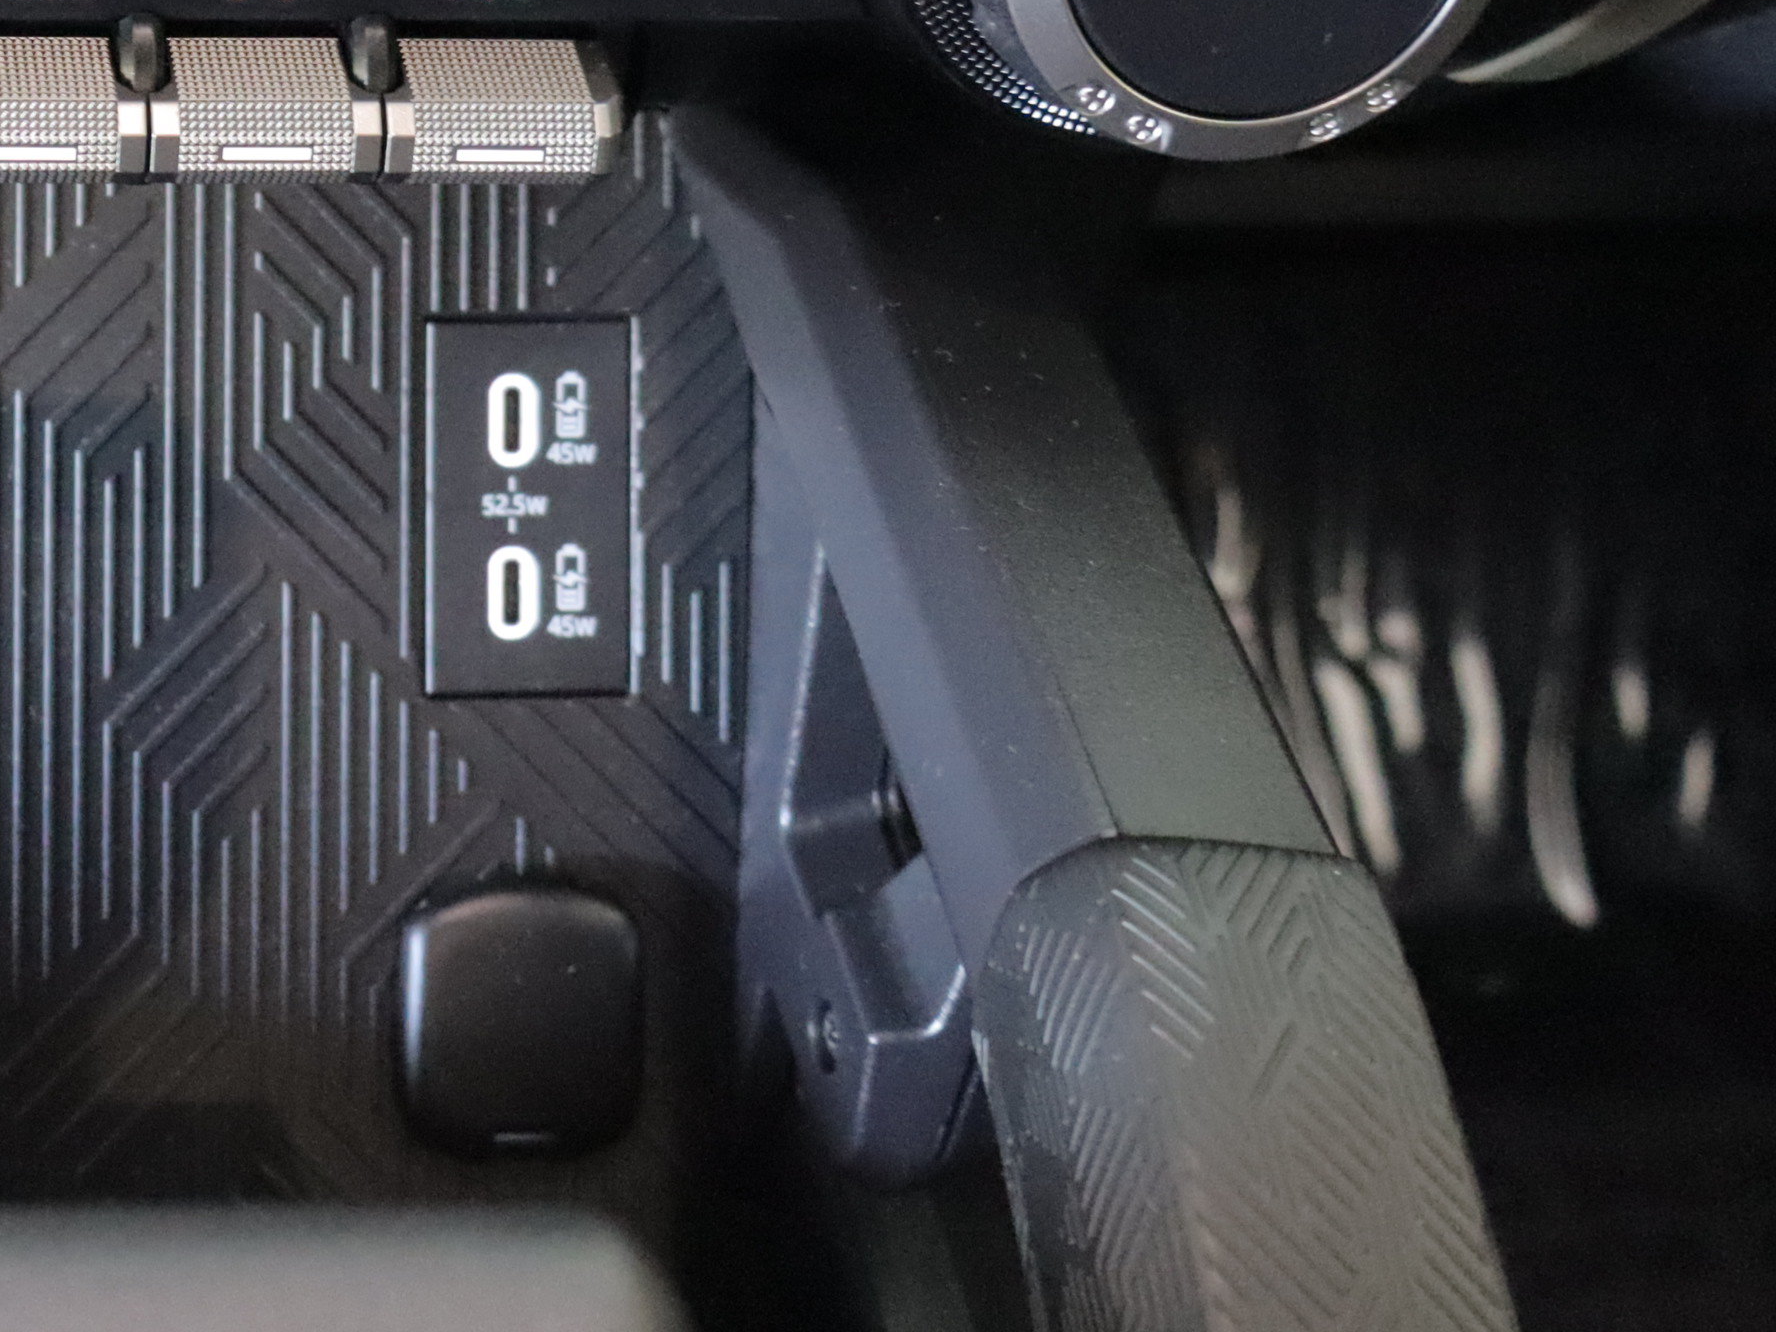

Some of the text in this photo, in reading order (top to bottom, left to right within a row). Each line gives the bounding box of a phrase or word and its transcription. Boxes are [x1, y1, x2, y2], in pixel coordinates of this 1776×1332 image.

[546, 442, 598, 465] 45W
[481, 494, 549, 517] 52.5W
[546, 615, 598, 638] 45W
